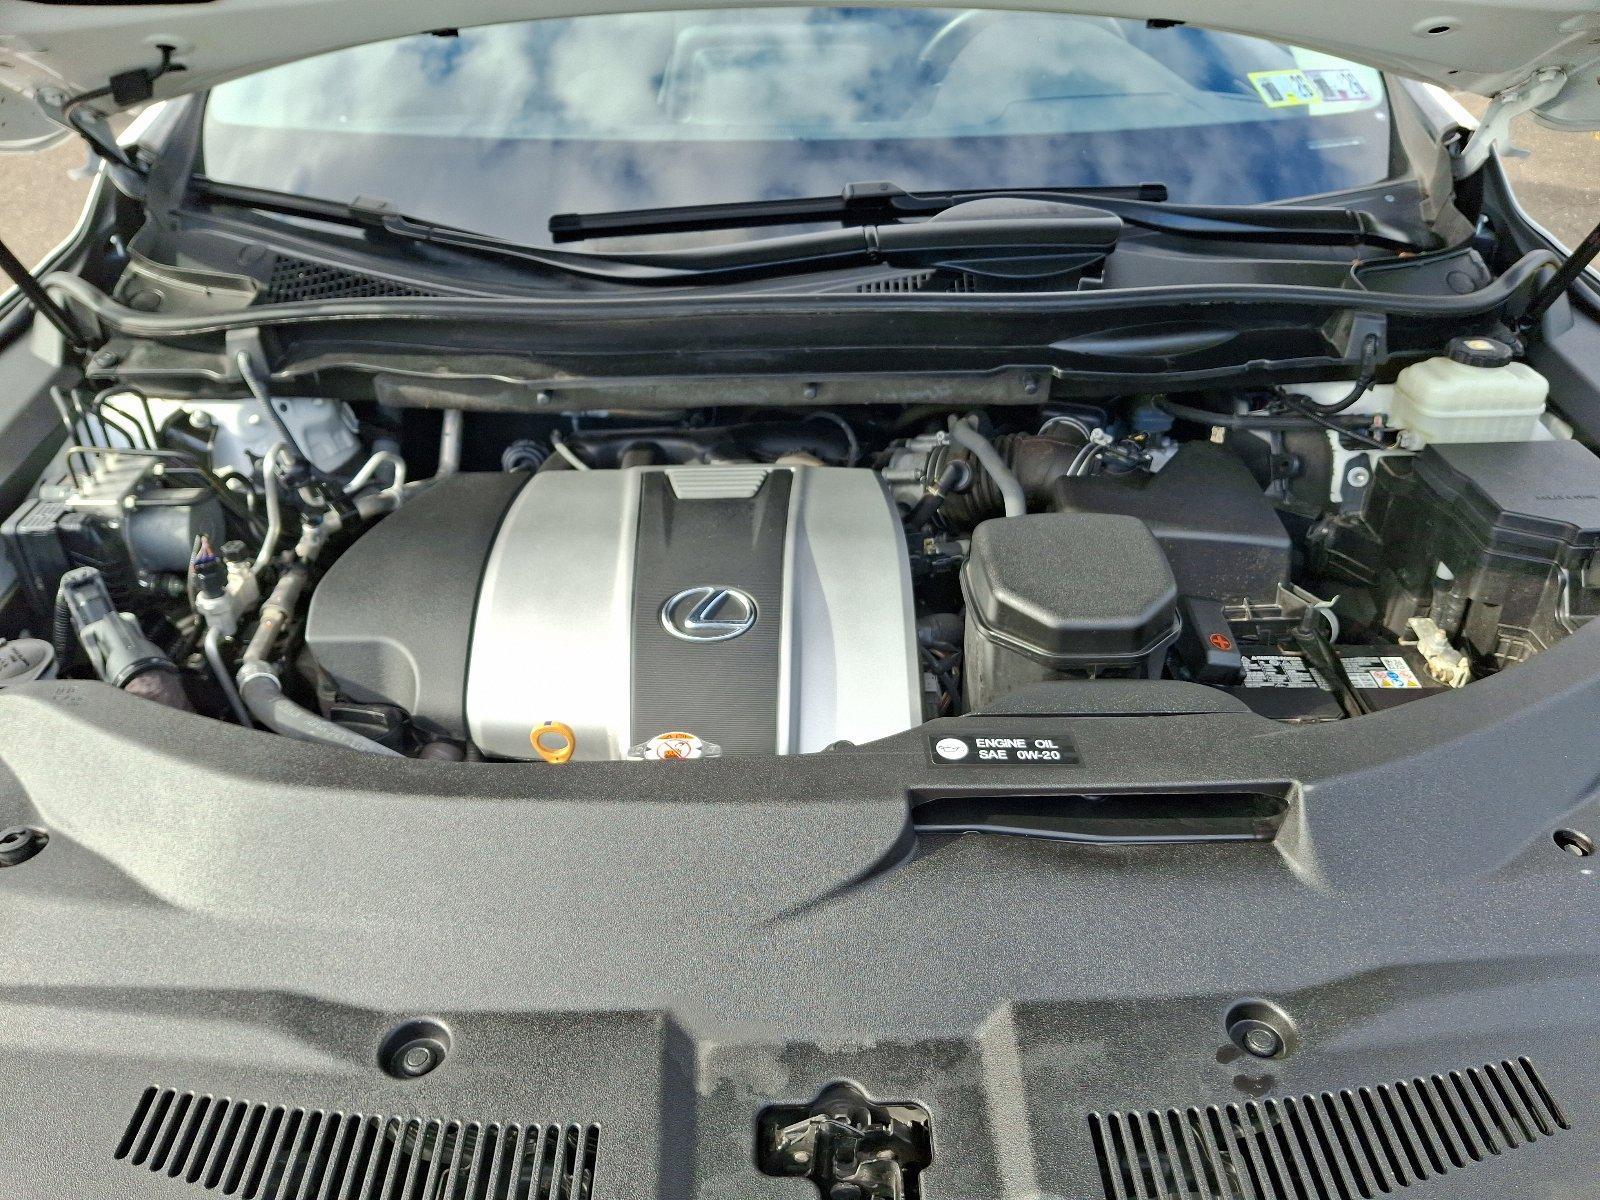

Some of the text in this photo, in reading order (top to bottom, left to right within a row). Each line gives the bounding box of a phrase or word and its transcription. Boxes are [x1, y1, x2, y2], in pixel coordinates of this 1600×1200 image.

[975, 738, 1059, 749] ENGINE OIL
[978, 749, 1061, 760] SAE 0W-20
